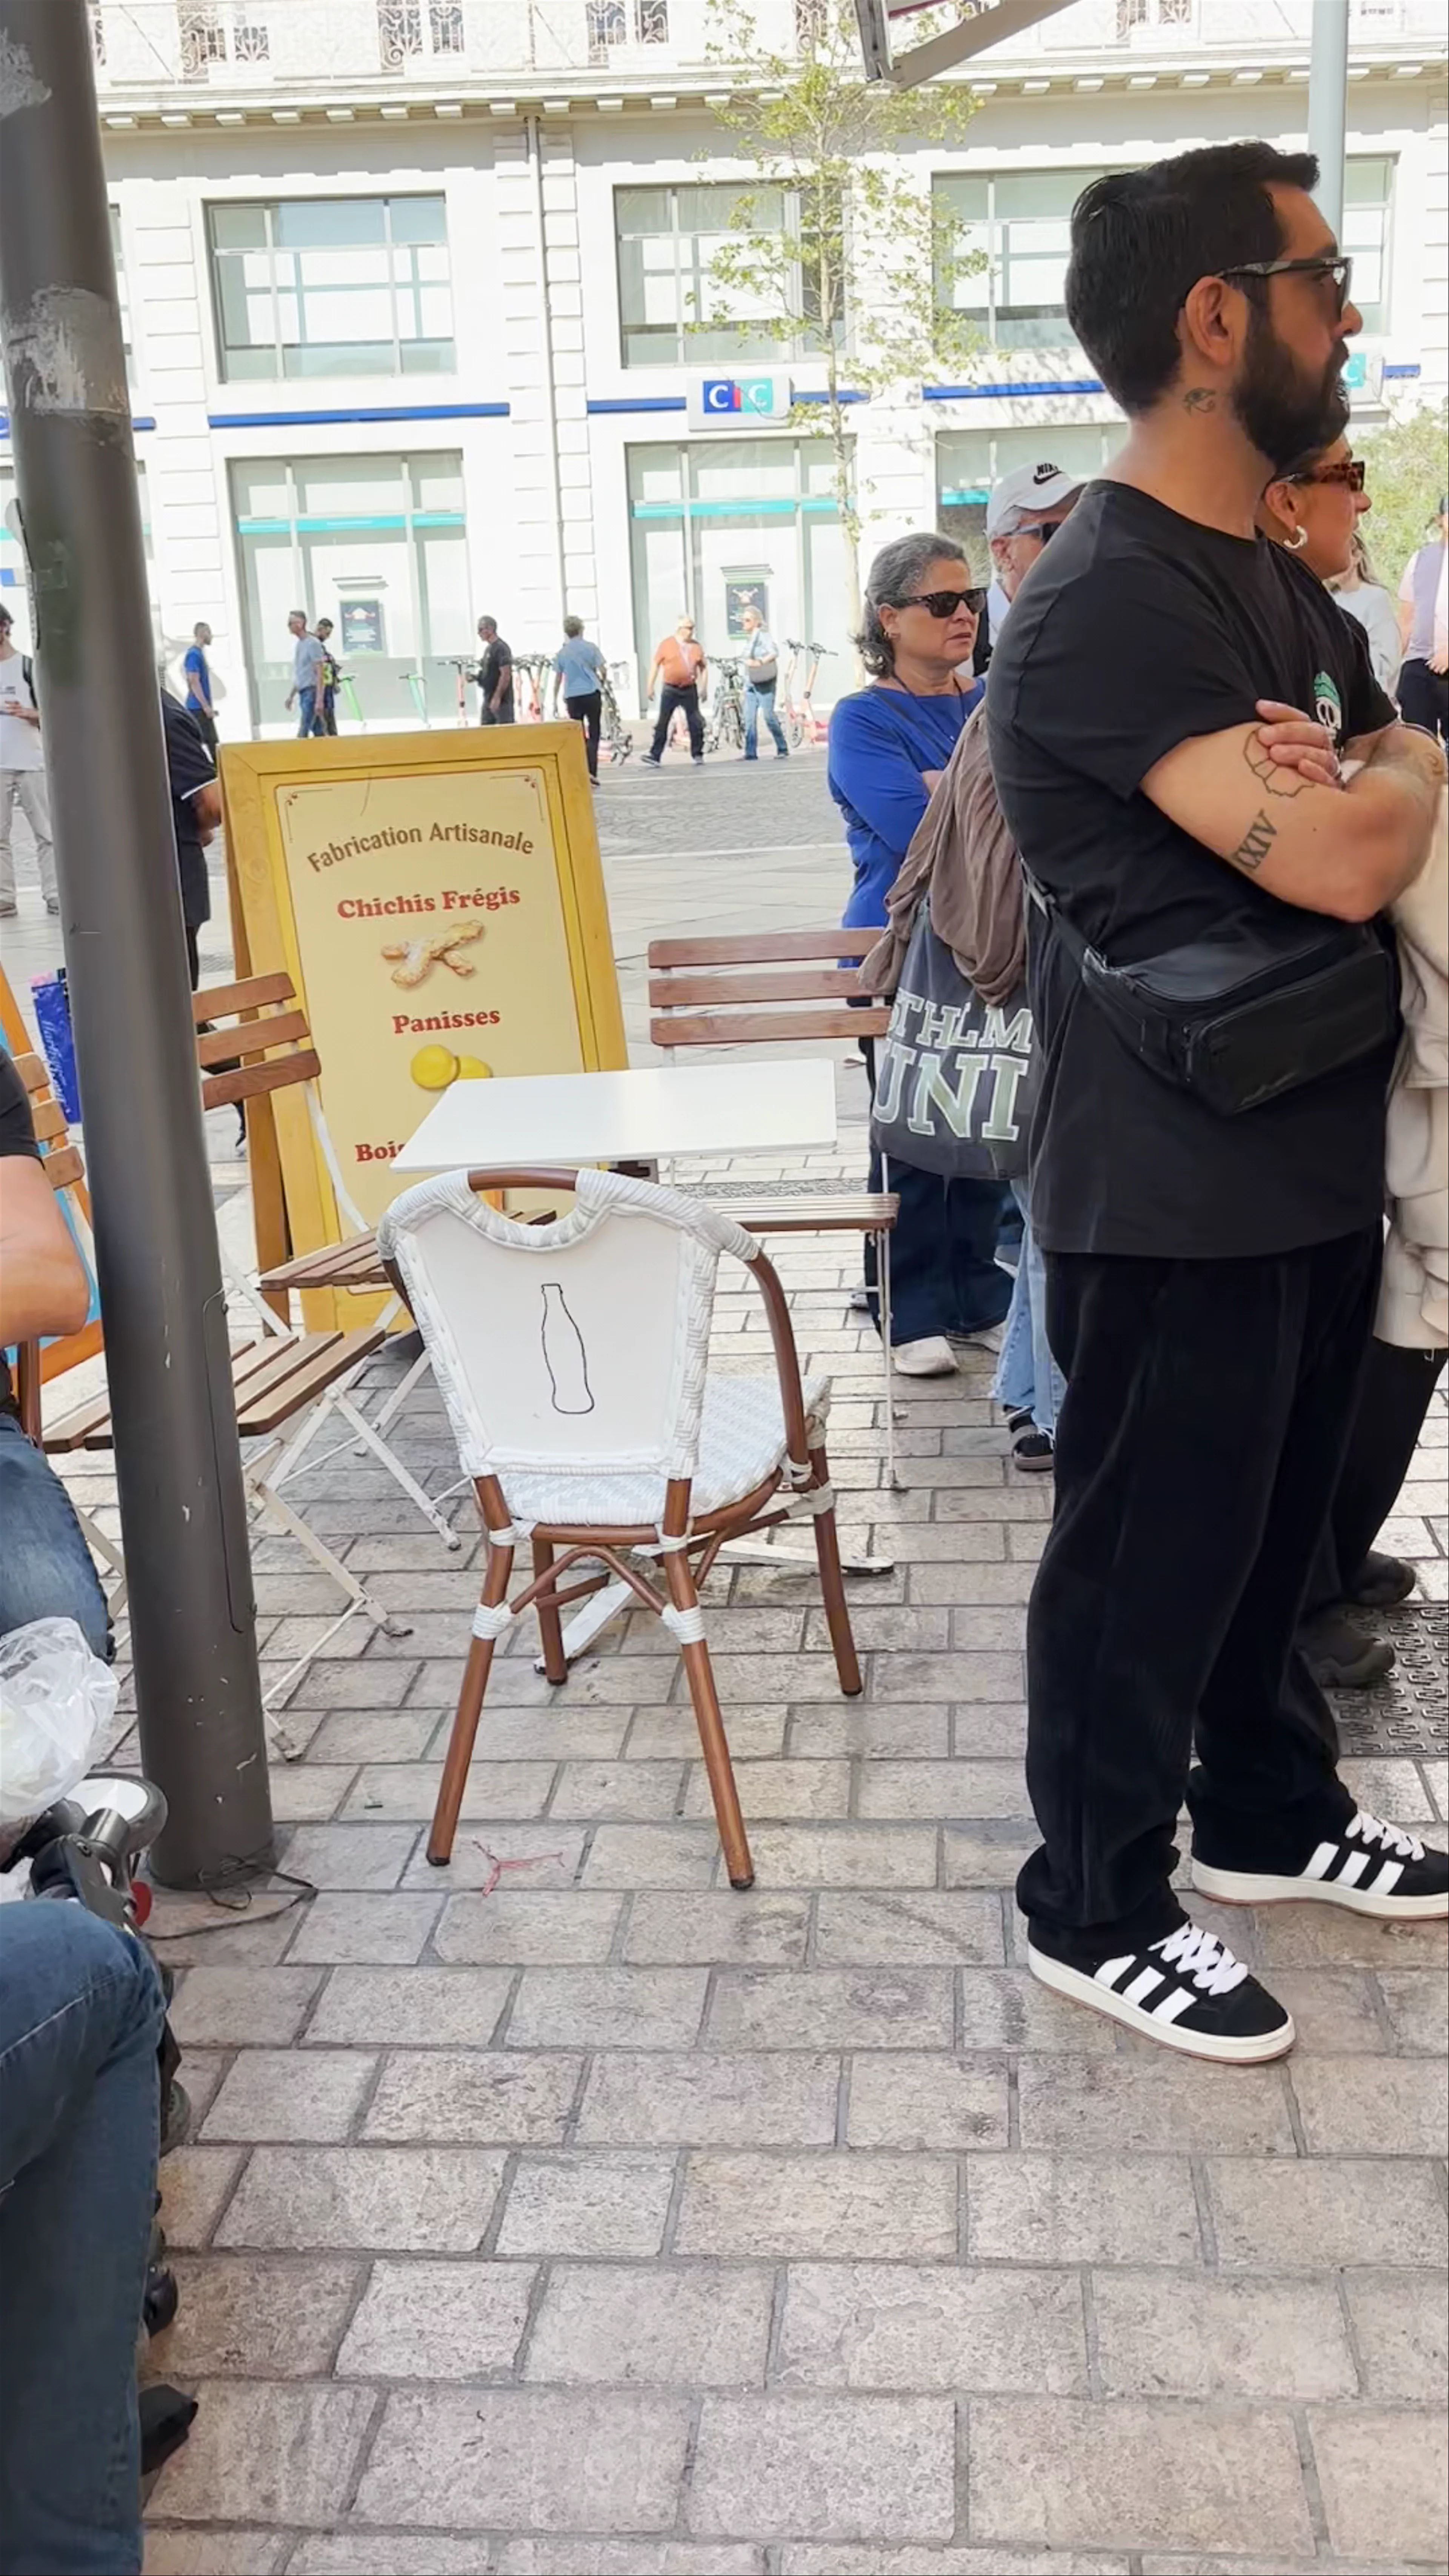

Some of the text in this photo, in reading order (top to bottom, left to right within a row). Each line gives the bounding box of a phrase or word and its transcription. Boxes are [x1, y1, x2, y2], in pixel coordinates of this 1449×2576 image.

[709, 383, 767, 408] CIC
[307, 823, 534, 872] Fabrication Artisanale
[338, 887, 520, 918] Chichis Frégis
[392, 1010, 500, 1033] Panisses
[872, 1042, 1029, 1141] UNI
